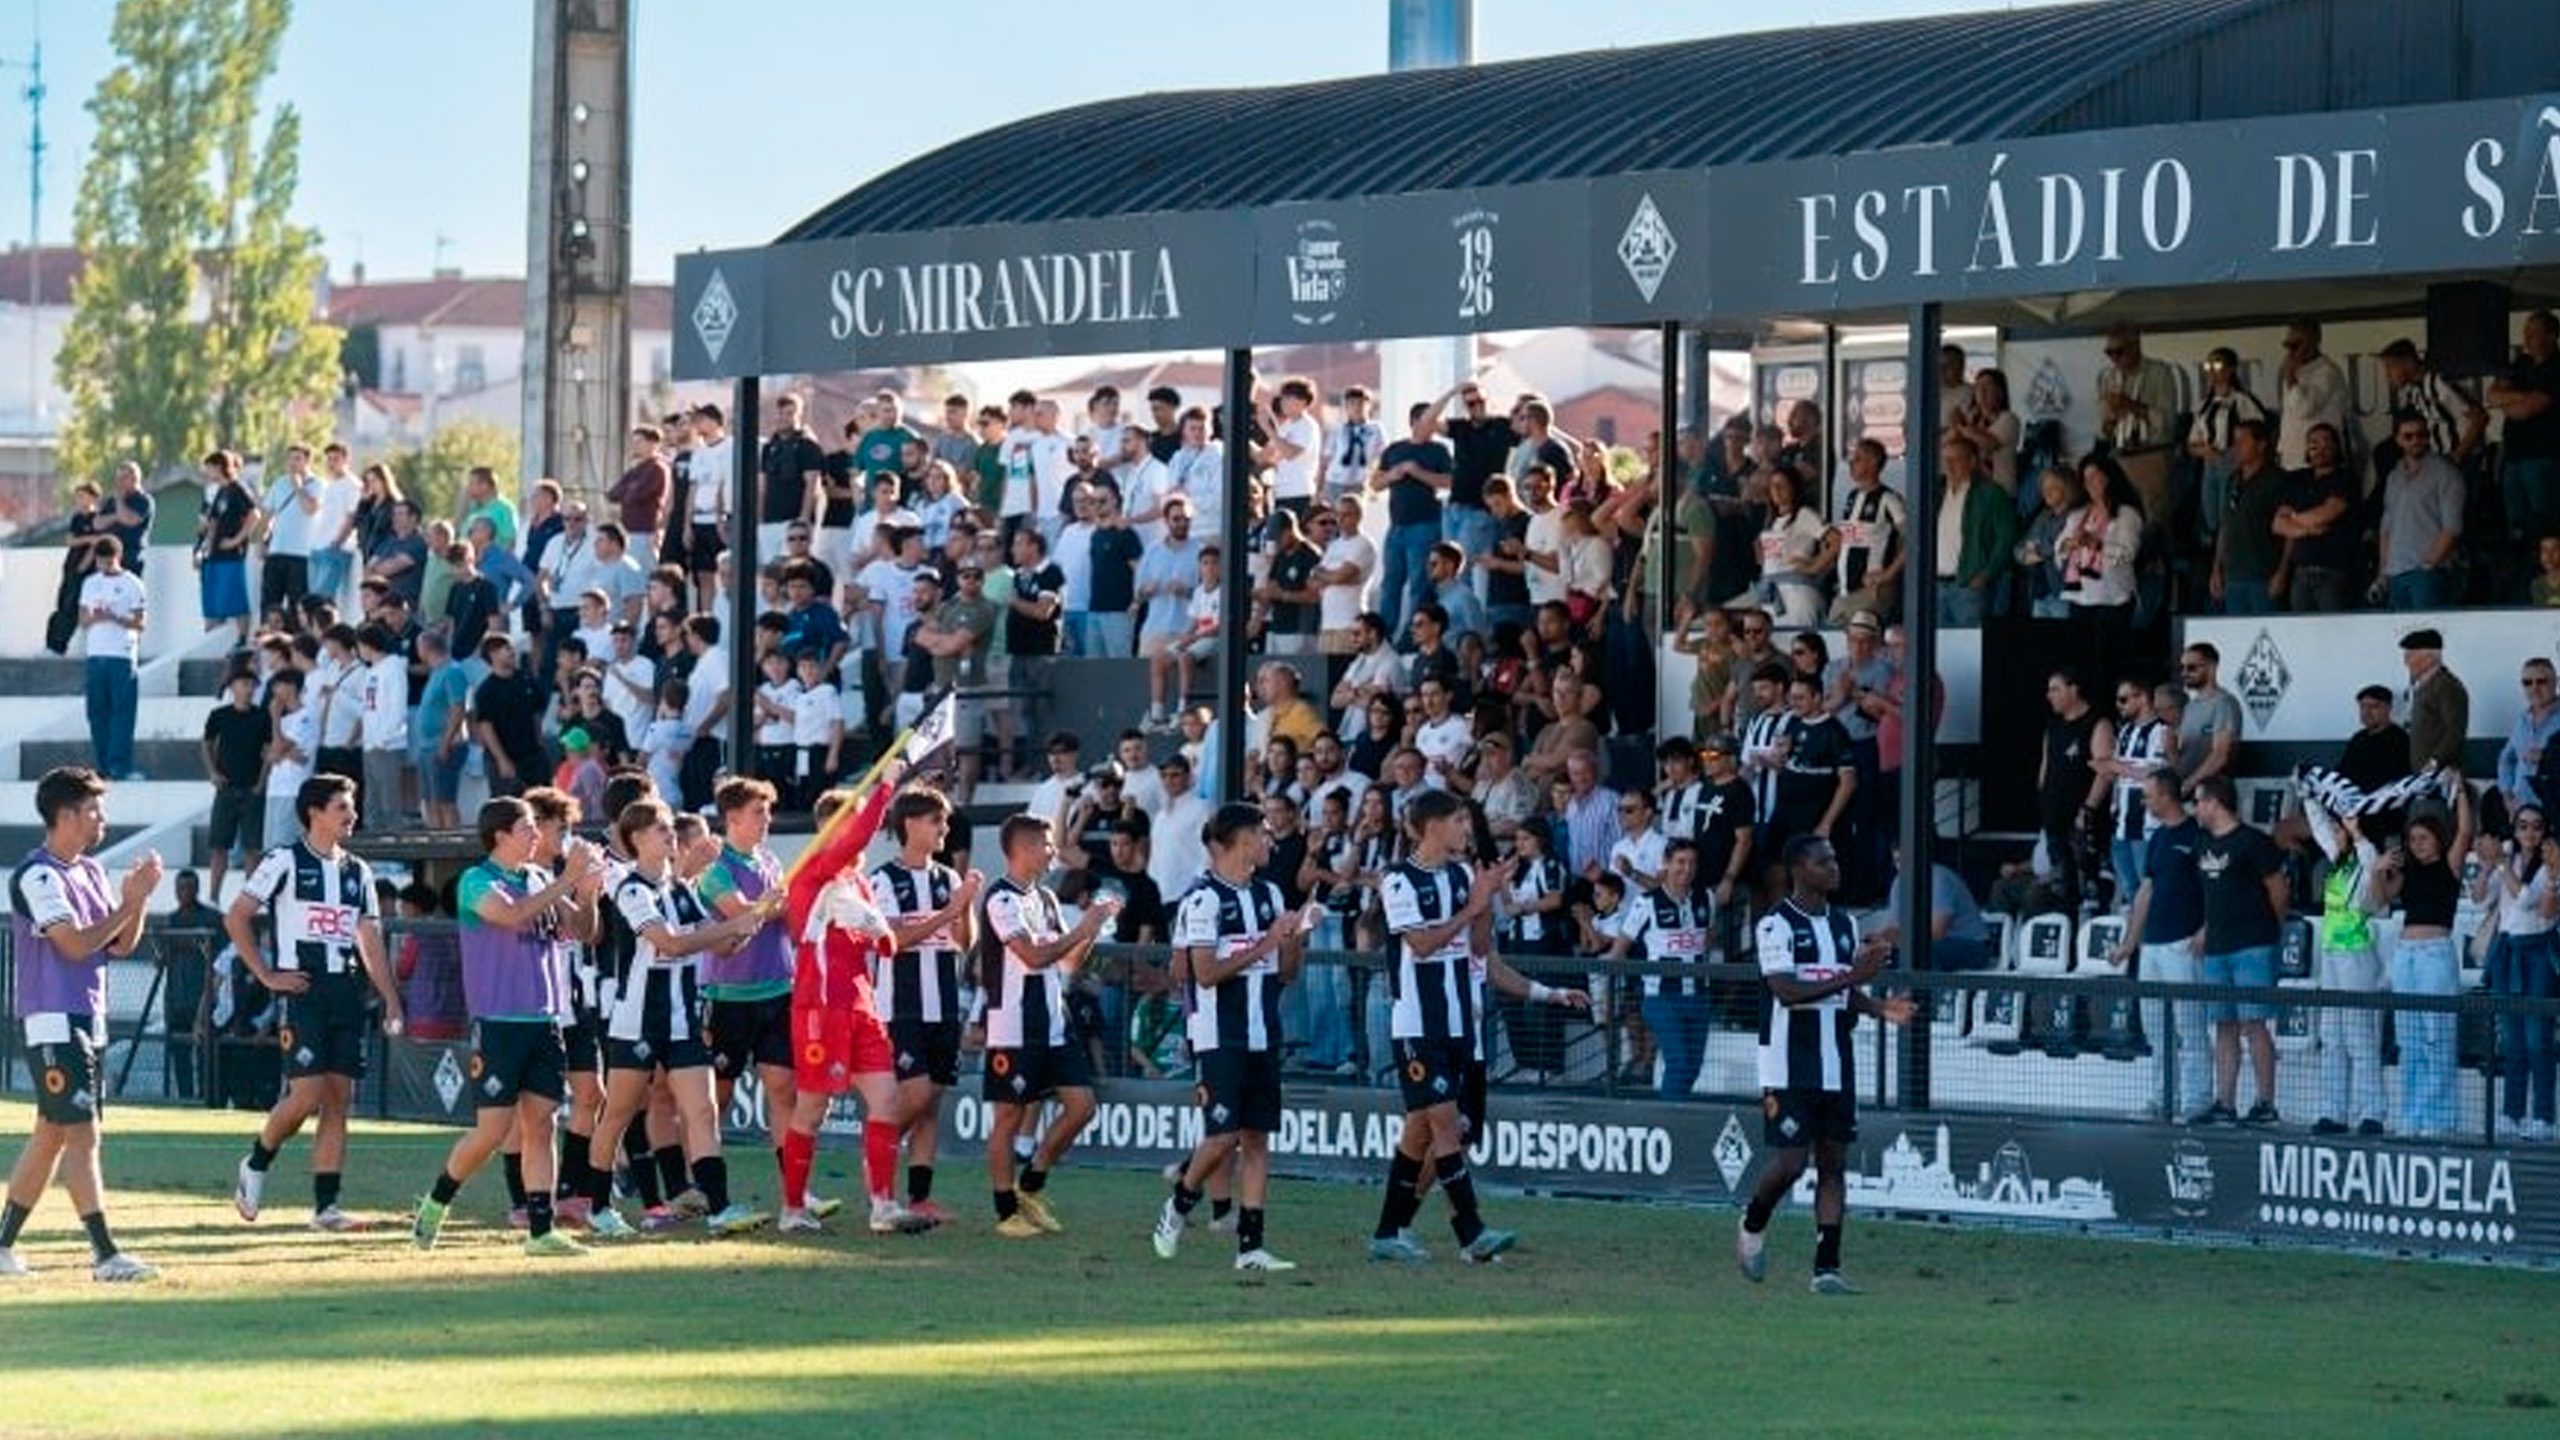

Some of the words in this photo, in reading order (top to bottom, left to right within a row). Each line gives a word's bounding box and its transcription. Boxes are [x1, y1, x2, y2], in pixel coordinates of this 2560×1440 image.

[1799, 154, 2193, 284] ESTÁDIO
[2272, 149, 2380, 252] DE
[830, 268, 884, 340] SC
[898, 247, 1180, 335] MIRANDELA
[955, 1096, 977, 1140] O
[1136, 1104, 1174, 1149] DE
[1497, 1120, 1672, 1175] DESPORTO
[2258, 1142, 2517, 1216] MIRANDELA
